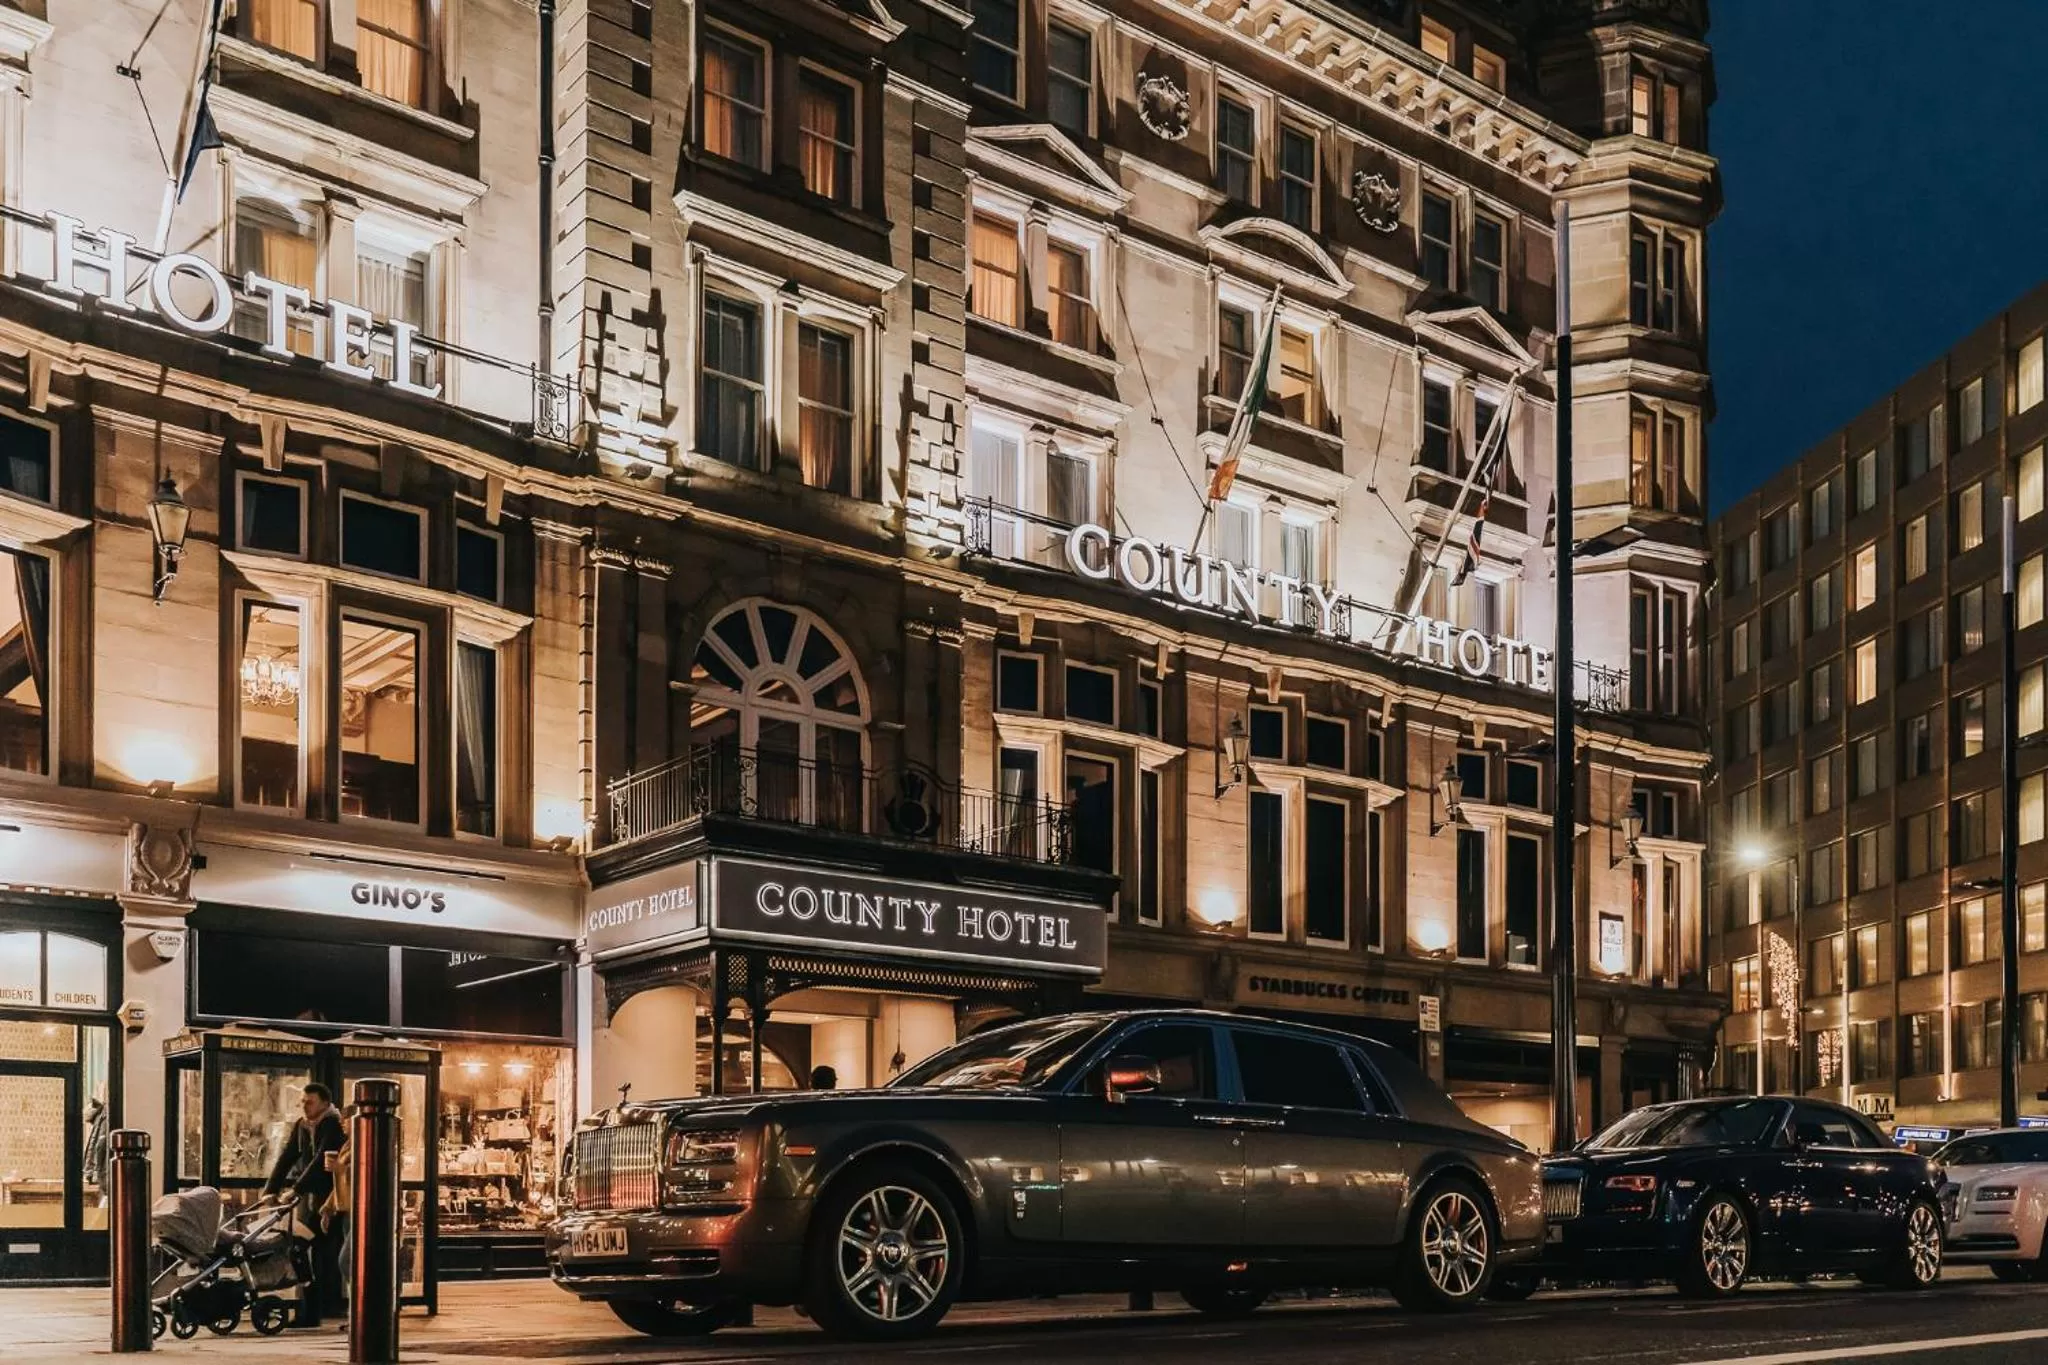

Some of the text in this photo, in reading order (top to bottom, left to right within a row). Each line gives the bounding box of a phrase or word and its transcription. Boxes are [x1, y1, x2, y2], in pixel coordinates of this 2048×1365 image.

[44, 210, 442, 398] HOTEL
[1065, 523, 1552, 691] COUNTY HOTE
[351, 881, 446, 914] GINO'S
[588, 883, 694, 930] COUNTY HOTEL
[756, 881, 1077, 950] COUNTY HOTEL
[54, 992, 97, 1006] CHILDREN
[1249, 974, 1347, 1000] STARBUCKS
[1875, 1098, 1890, 1113] M
[573, 1231, 599, 1253] HY64
